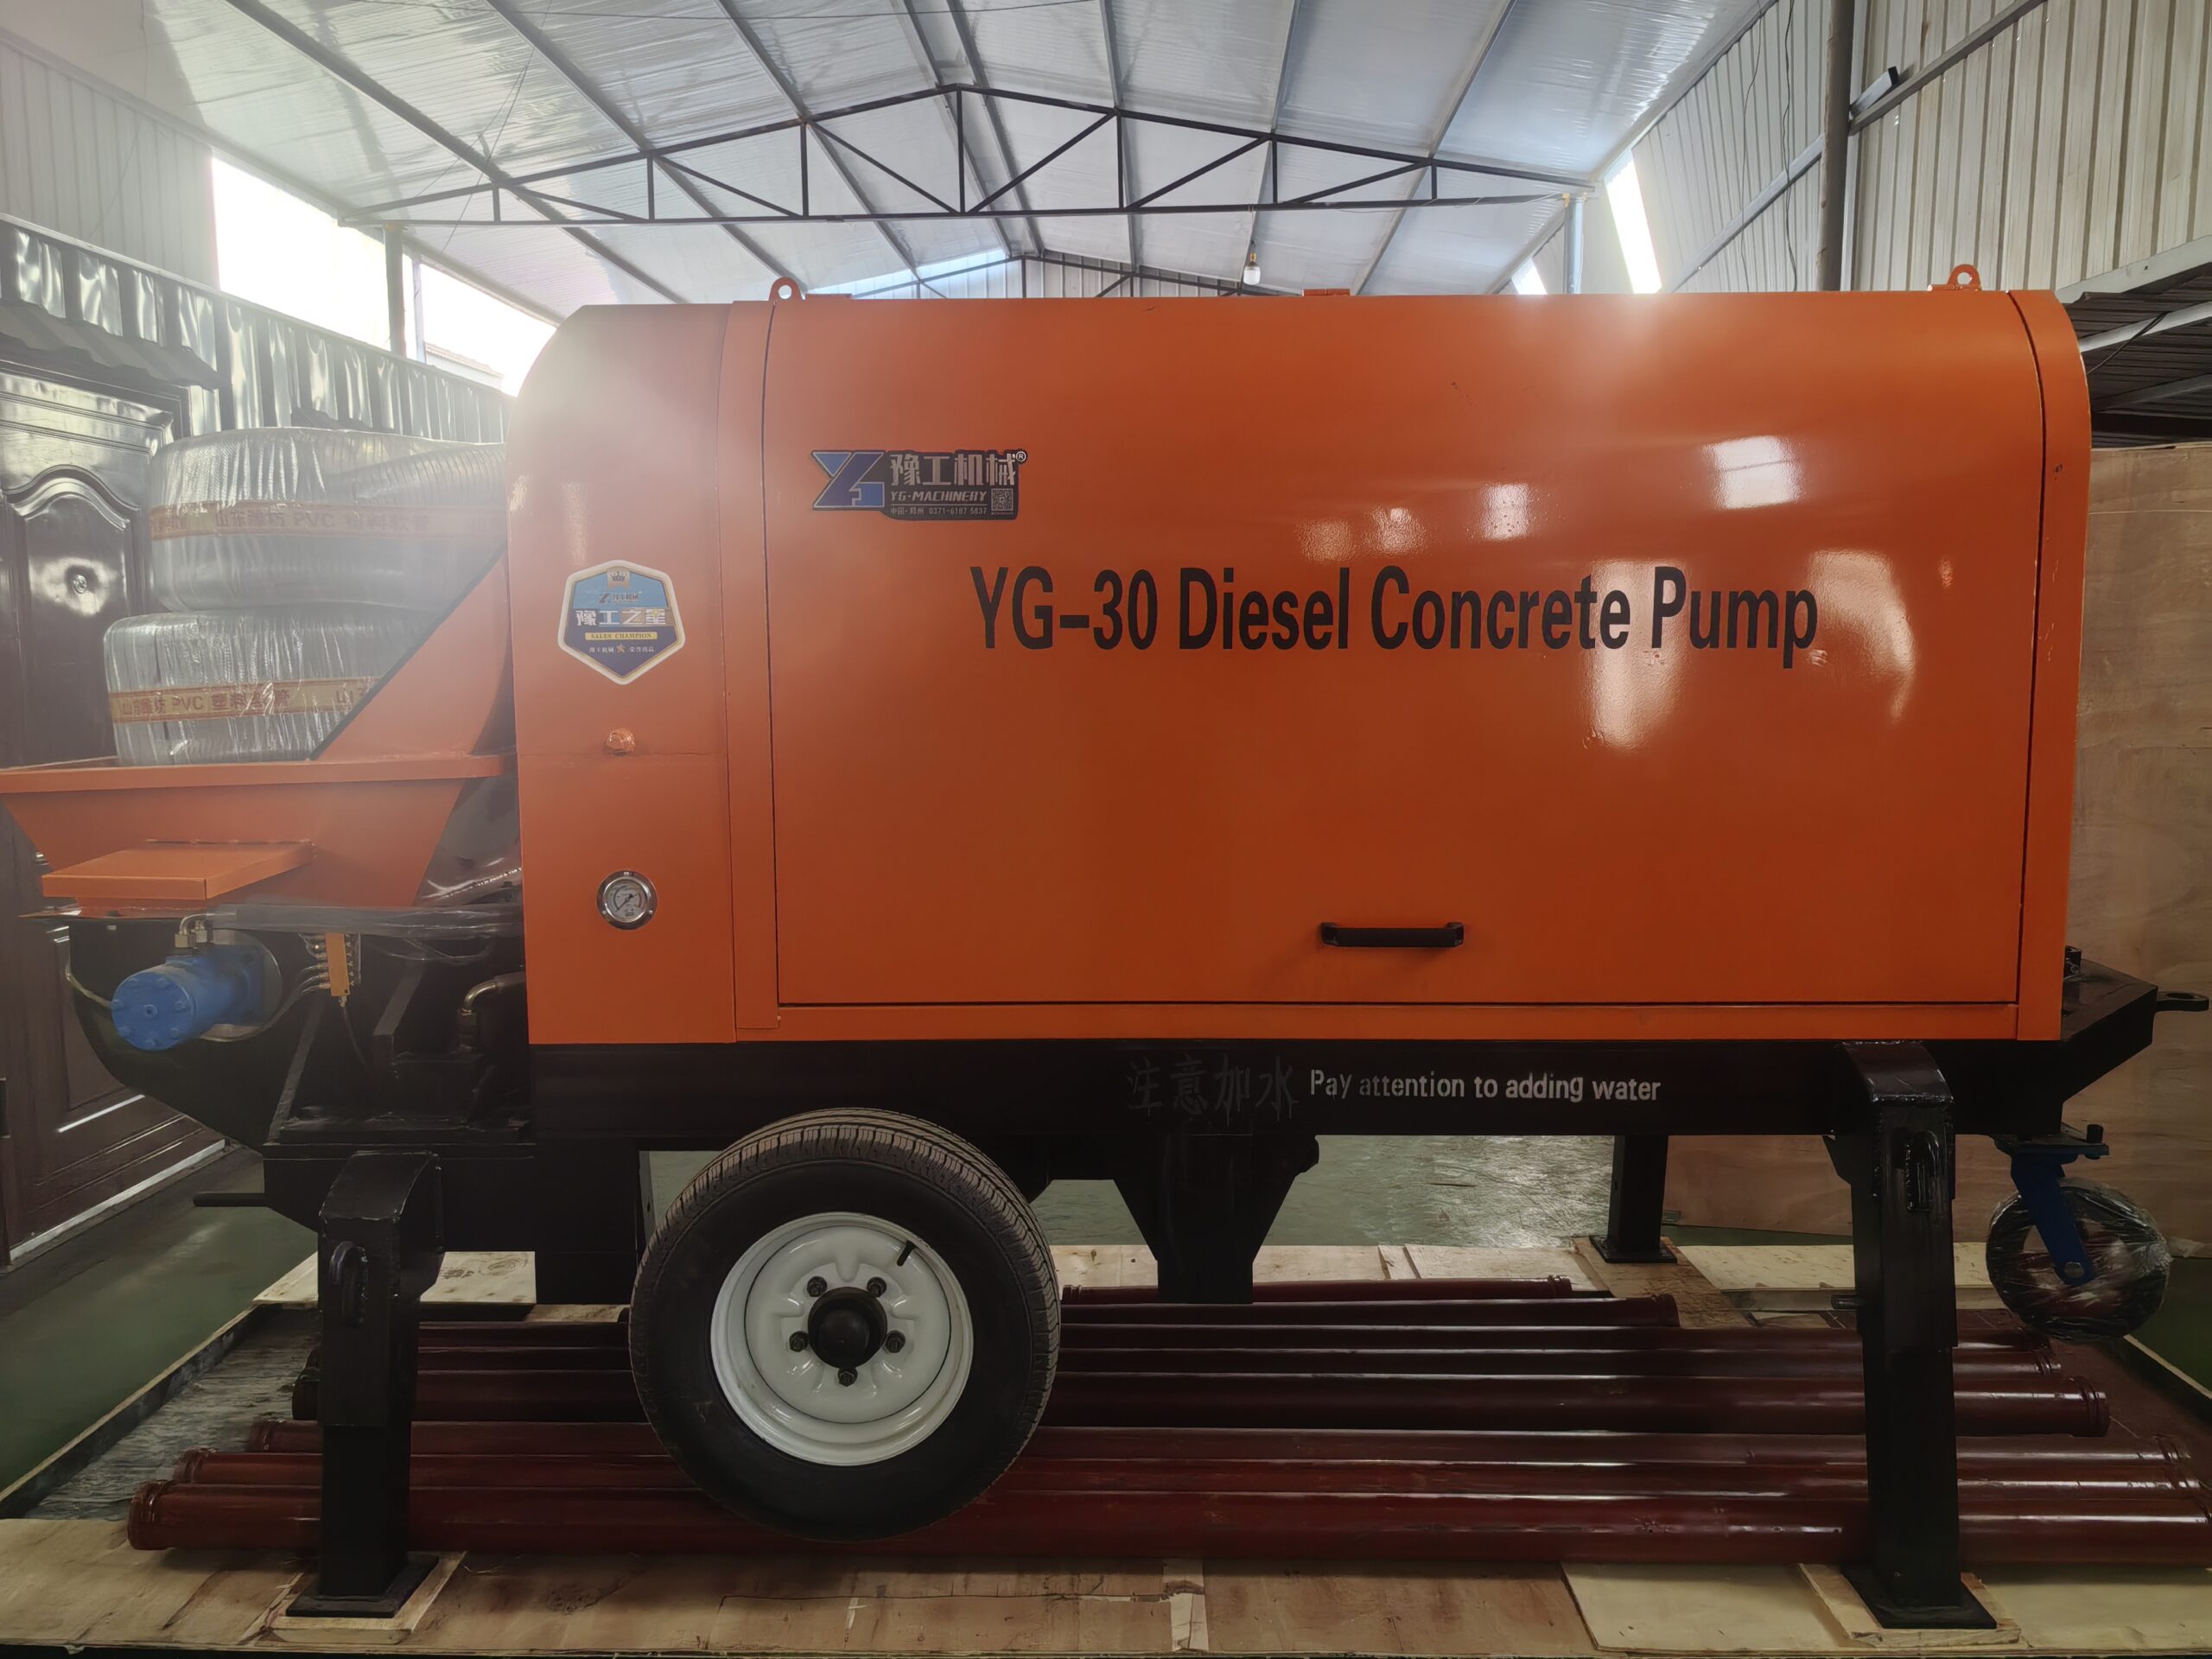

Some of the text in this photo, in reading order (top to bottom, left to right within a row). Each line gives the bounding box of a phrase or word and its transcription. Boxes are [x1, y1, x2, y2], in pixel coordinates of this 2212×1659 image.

[890, 453, 1016, 486] 豫工机械
[292, 511, 336, 529] PVC
[970, 565, 1818, 670] YG-30 Diesel Concrete Pump
[172, 695, 204, 712] PVC
[1126, 1053, 1298, 1125] 注意加水
[1310, 1069, 1662, 1103] Pay attention to adding water
